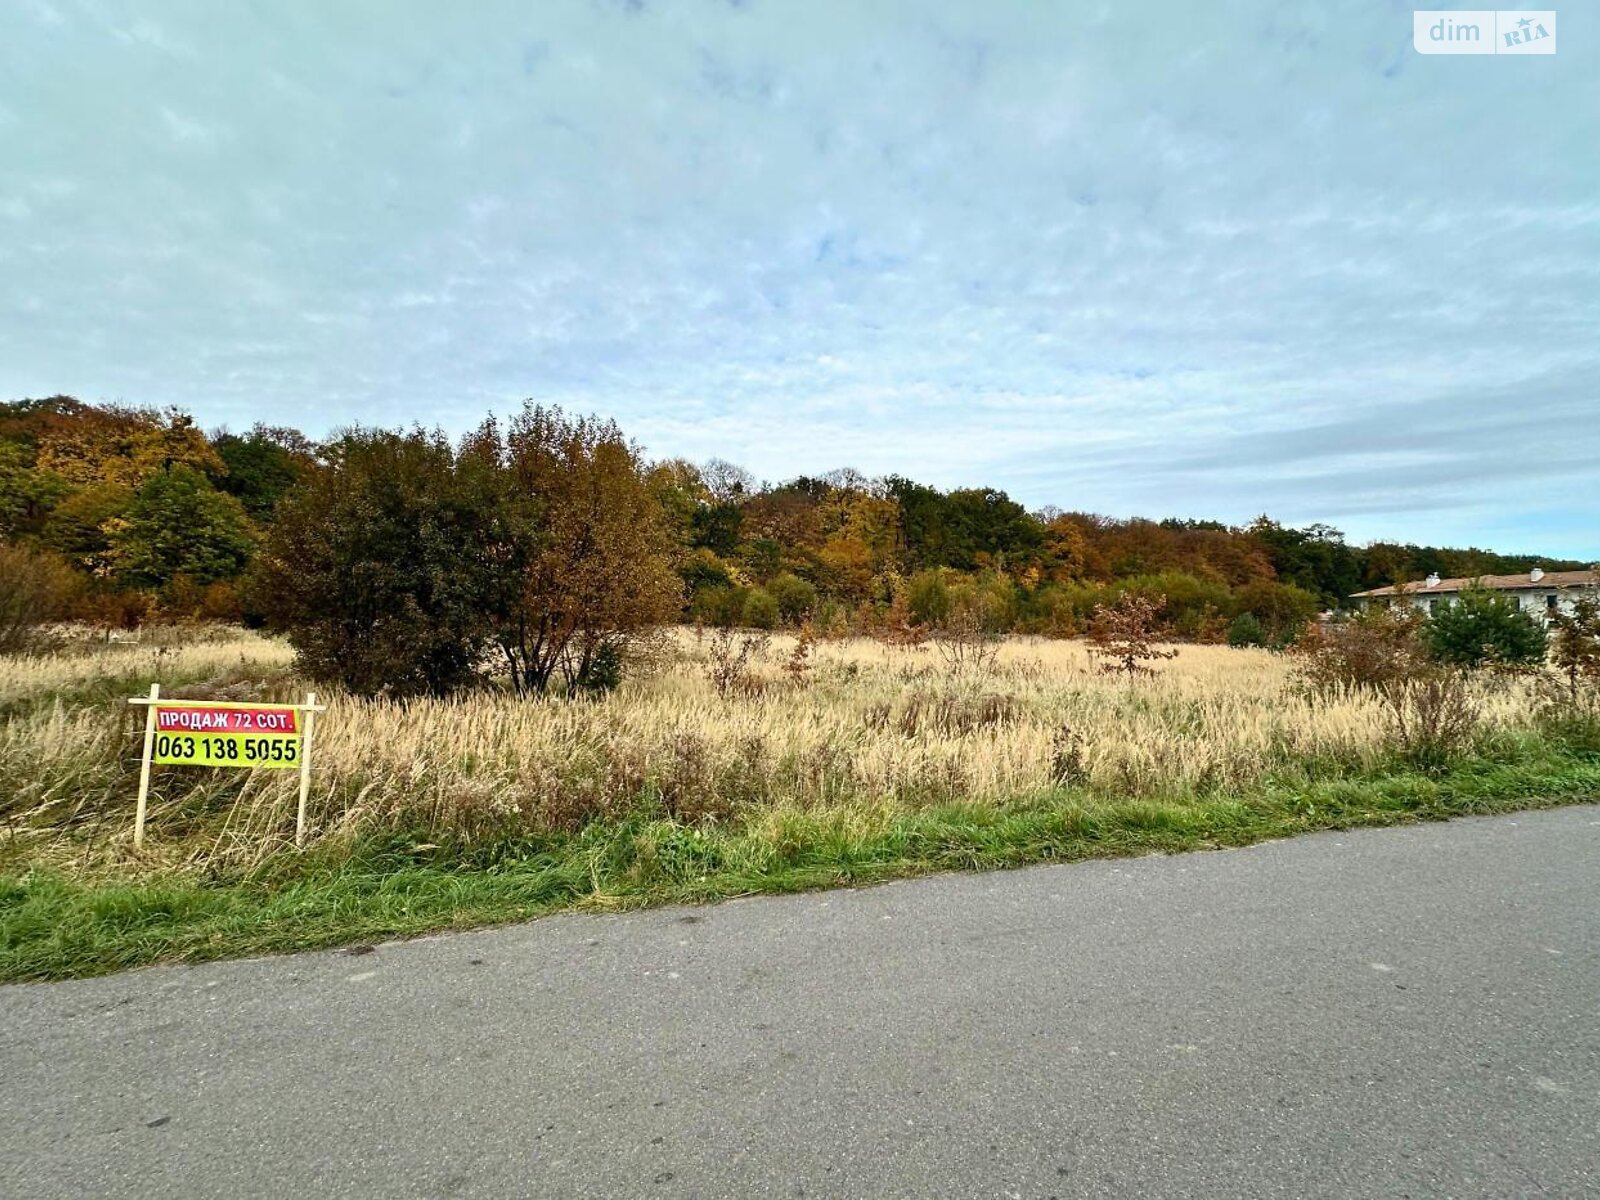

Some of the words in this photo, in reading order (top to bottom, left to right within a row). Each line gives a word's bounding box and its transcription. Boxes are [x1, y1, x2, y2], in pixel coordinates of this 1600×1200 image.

[159, 711, 229, 729] ПРОДАЖ
[234, 713, 252, 728] 72
[256, 714, 293, 729] СОТ.
[158, 736, 195, 758] 063
[202, 738, 238, 760] 138
[245, 739, 296, 761] 5055
